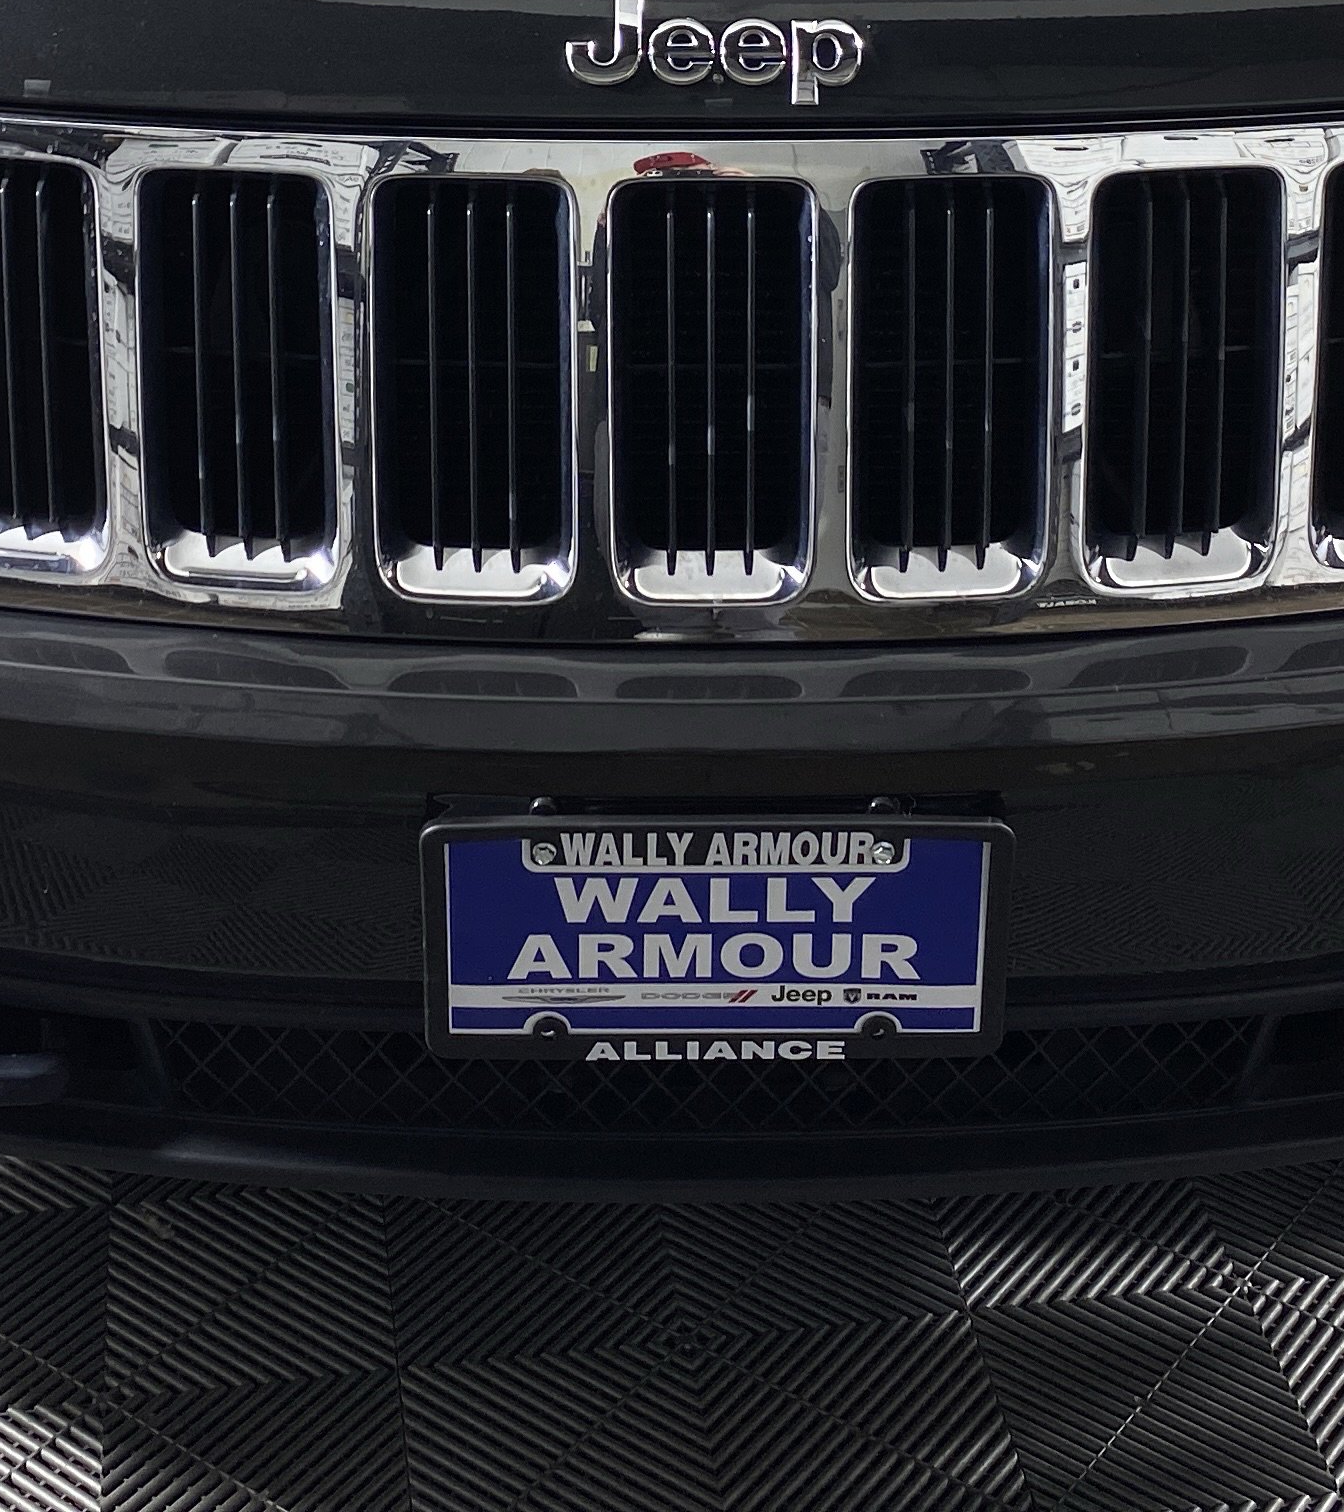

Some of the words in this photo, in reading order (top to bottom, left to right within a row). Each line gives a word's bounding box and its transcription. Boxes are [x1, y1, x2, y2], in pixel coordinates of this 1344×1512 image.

[560, 832, 694, 866] WALLY
[705, 831, 875, 866] ARMOUR
[554, 877, 876, 923] WALLY
[507, 933, 920, 980] ARMOUR
[771, 985, 832, 1005] Jeep
[866, 992, 917, 1001] RAM
[585, 1041, 846, 1061] ALLIANCE
